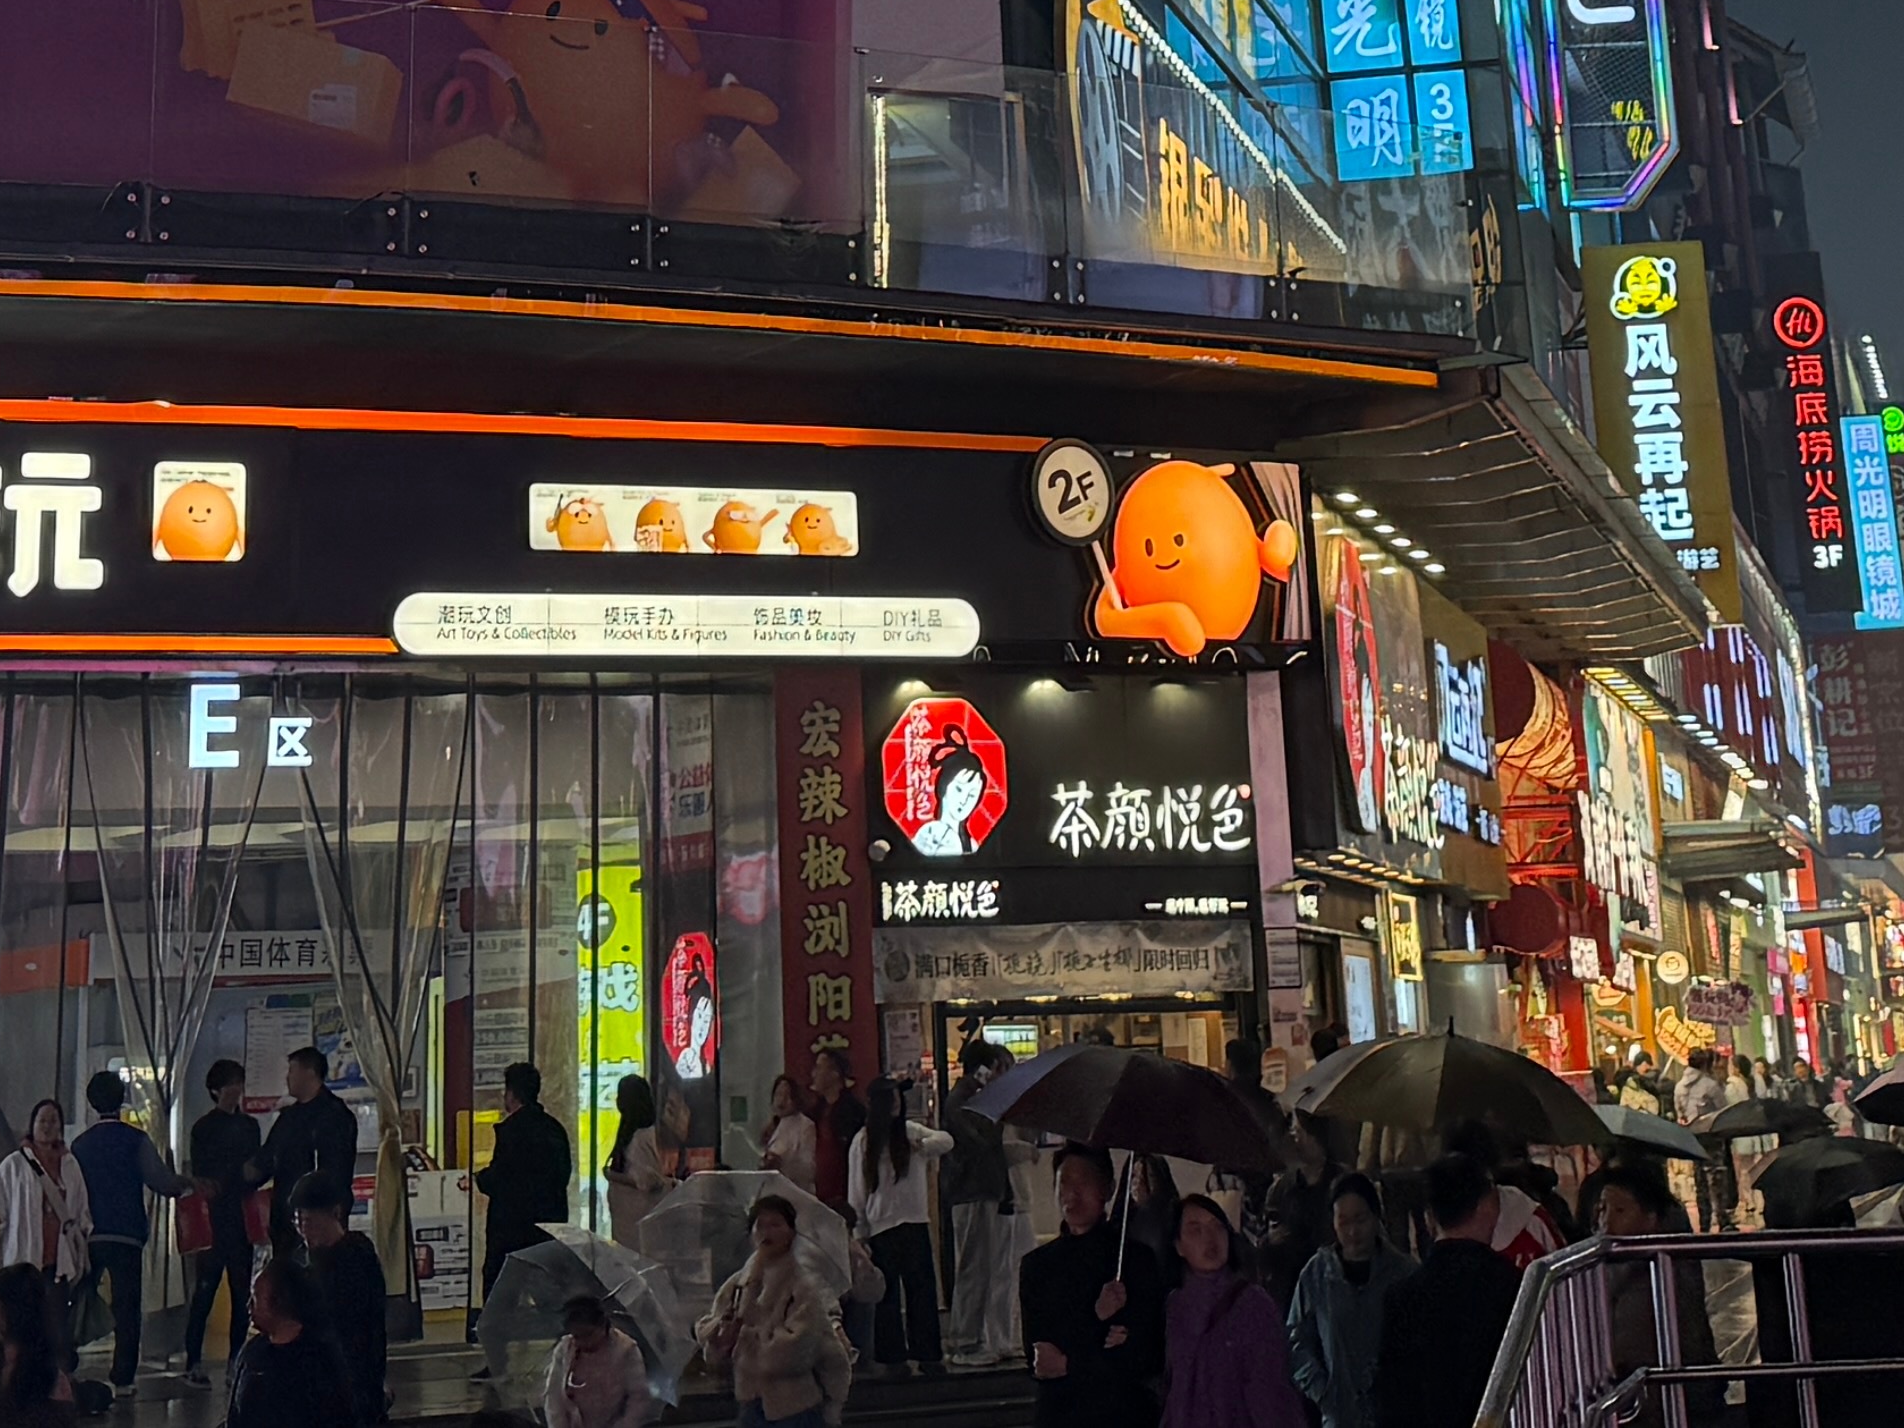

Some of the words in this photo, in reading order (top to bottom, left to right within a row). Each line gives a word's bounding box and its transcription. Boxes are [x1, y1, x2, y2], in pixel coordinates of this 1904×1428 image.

[1047, 469, 1095, 515] 2F
[1623, 322, 1695, 543] 风云再起
[1786, 353, 1844, 541] 海底捞火锅
[1812, 545, 1845, 570] 3F
[1849, 422, 1903, 621] 周光明眼镜城
[798, 700, 854, 1055] 宏辣椒浏阳
[1048, 780, 1252, 858] 茶颜悦色
[893, 879, 1000, 922] 茶颜悦色
